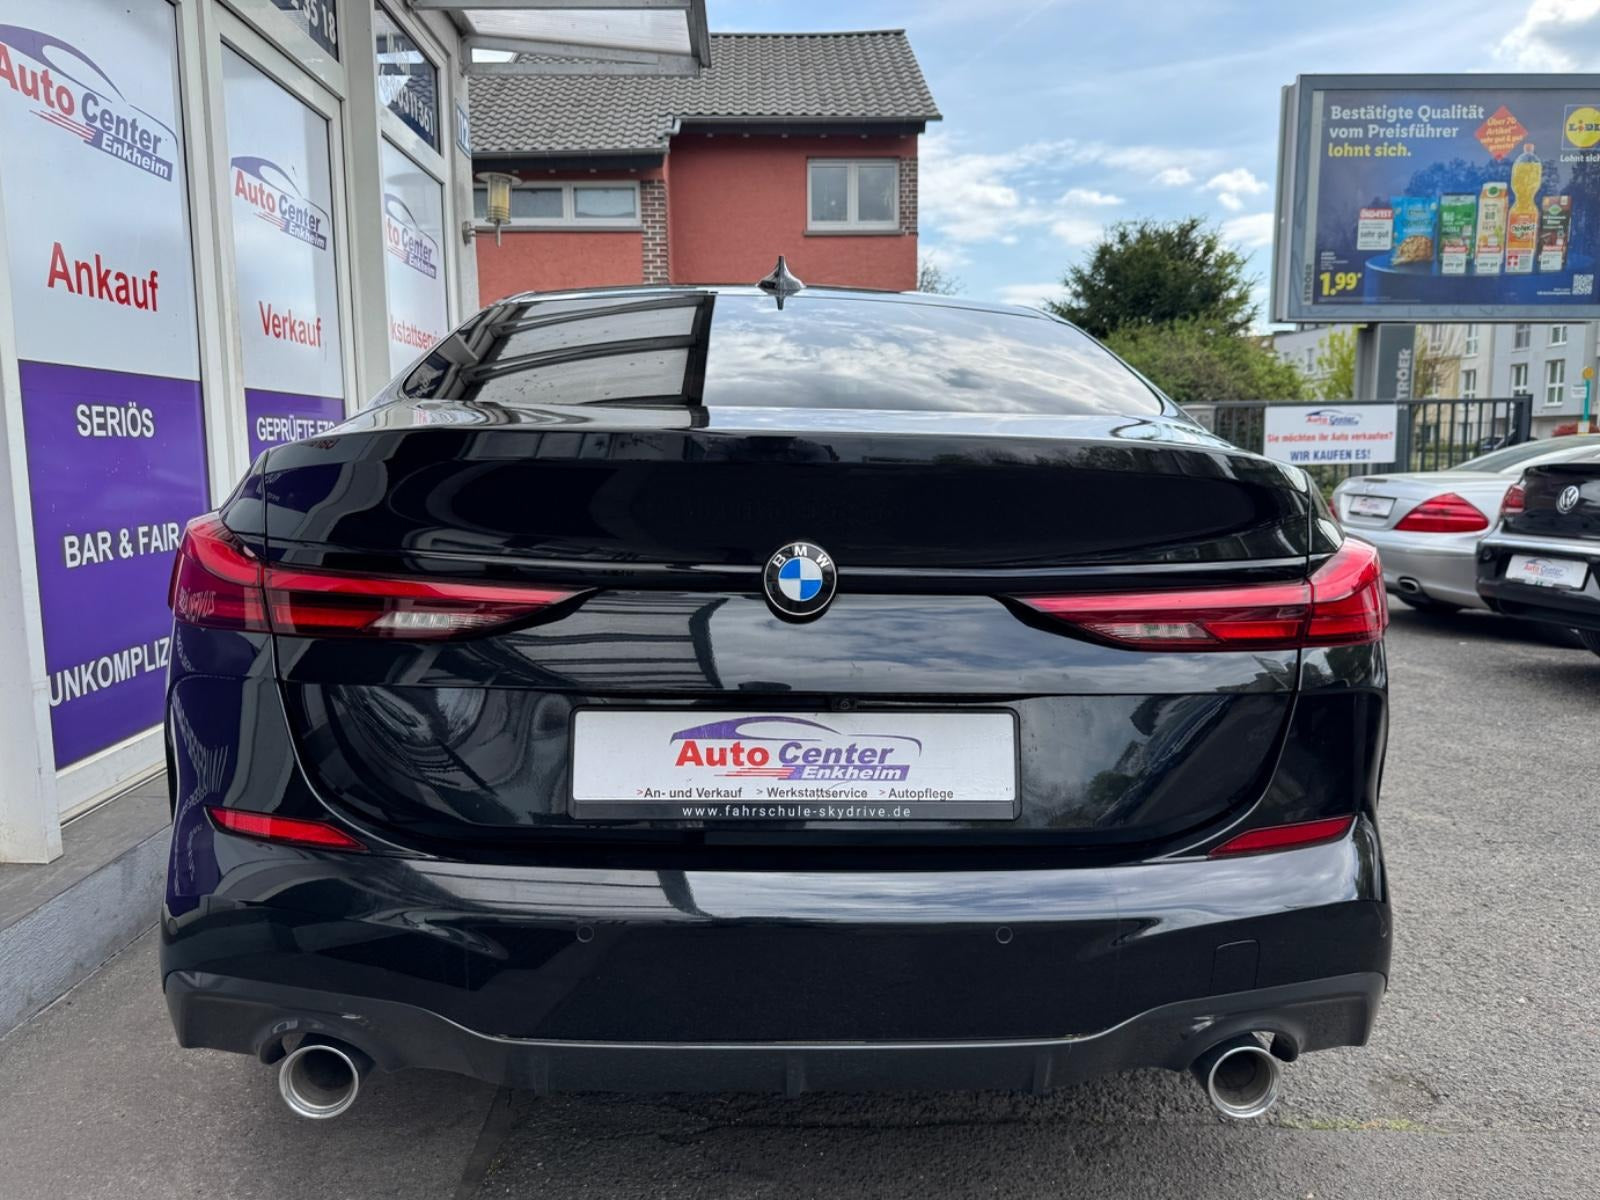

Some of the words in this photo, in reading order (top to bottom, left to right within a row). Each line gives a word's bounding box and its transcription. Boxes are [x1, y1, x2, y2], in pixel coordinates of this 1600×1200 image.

[0, 43, 75, 117] Auto
[81, 92, 161, 154] Center
[1330, 105, 1414, 123] Bestätigte
[1418, 105, 1484, 120] Qualität
[1329, 127, 1363, 138] vom
[1368, 124, 1459, 139] Preisführer
[101, 131, 168, 178] Enkheim
[1328, 143, 1371, 157] lohnt
[1375, 143, 1411, 157] sich.
[1560, 153, 1584, 162] Lohnt
[235, 170, 276, 214] Auto
[279, 194, 321, 232] Center
[288, 222, 326, 249] Enkheim
[401, 228, 433, 261] Center
[48, 242, 158, 312] Ankauf
[258, 300, 322, 348] Verkauf
[76, 402, 154, 438] SERIÖS
[256, 414, 315, 442] GEPRÜFTE
[1306, 416, 1328, 425] Auto
[1267, 434, 1279, 443] Sie
[1282, 433, 1316, 443] möchten
[1331, 432, 1349, 441] Auto
[1351, 431, 1393, 442] verkaufen?
[1290, 450, 1310, 462] WIR
[1313, 449, 1352, 461] KAUFEN
[1355, 449, 1371, 460] ES!
[64, 535, 115, 569] BAR
[118, 528, 134, 558] &
[139, 522, 181, 554] FAIR
[49, 636, 170, 707] UNKOMPLIZ
[675, 740, 770, 767] Auto
[778, 741, 896, 764] Center
[801, 766, 902, 780] Enkheim
[644, 787, 667, 798] An-
[669, 787, 692, 799] und
[696, 787, 743, 799] Verkauf
[767, 787, 868, 799] Werkstattservice
[889, 787, 954, 802] Autopflege
[682, 805, 911, 819] www.fahrschule-skydrive.de
